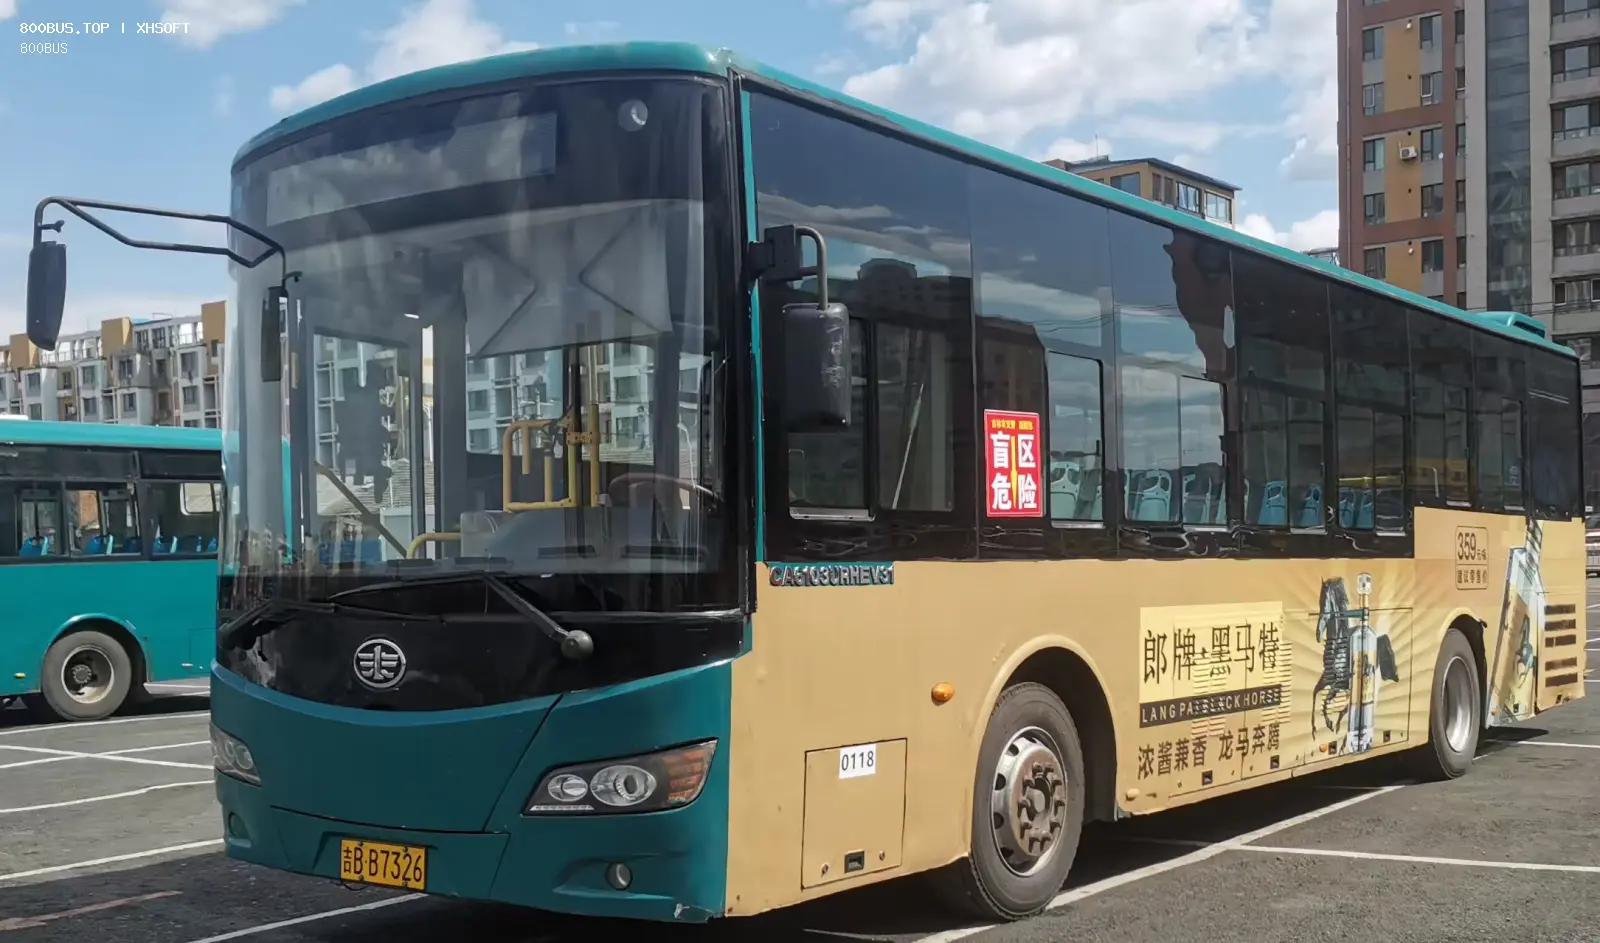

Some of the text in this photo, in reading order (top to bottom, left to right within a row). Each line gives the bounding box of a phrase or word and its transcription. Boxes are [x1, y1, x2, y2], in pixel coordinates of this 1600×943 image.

[1142, 703, 1176, 723] LANG
[1243, 688, 1281, 706] HORSE
[841, 750, 874, 771] 0118
